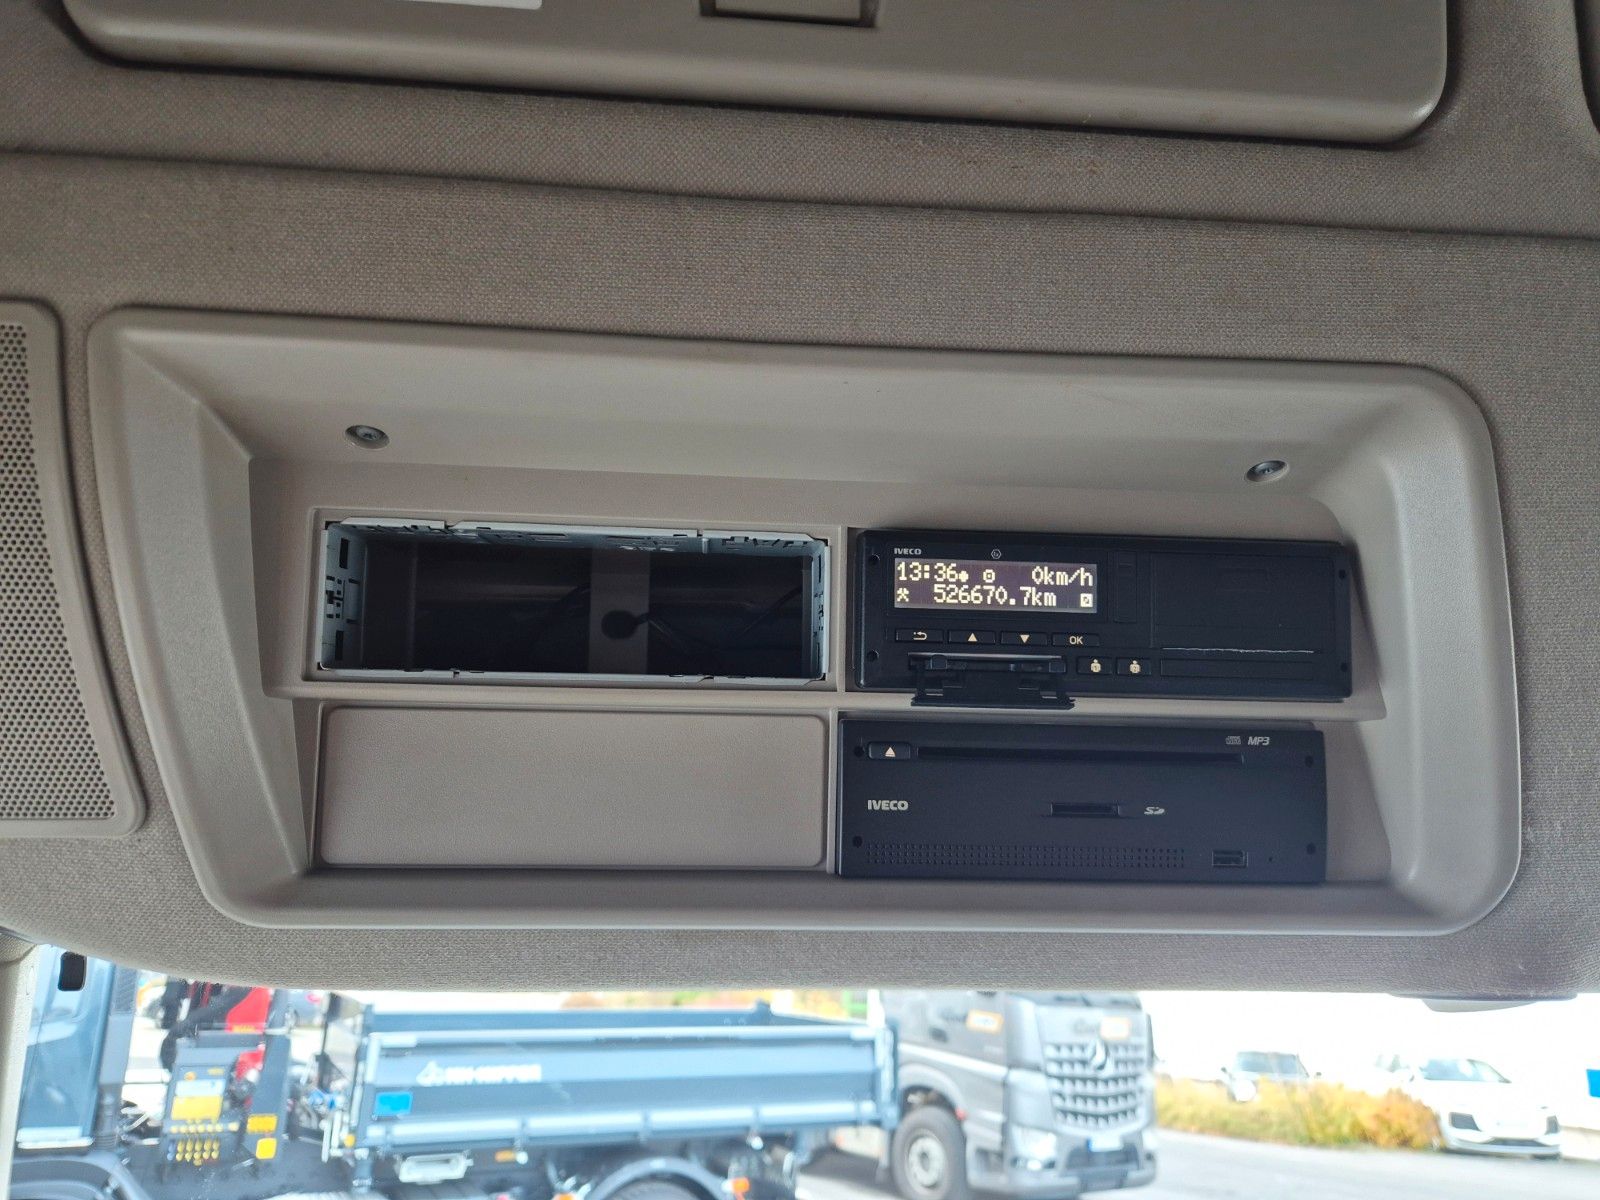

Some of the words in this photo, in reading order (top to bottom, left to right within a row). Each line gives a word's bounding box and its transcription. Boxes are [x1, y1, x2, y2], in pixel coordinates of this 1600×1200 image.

[894, 547, 922, 556] IVECO
[897, 561, 957, 582] 13:36
[1031, 565, 1094, 587] 0km/h
[933, 584, 1057, 608] 526670.7km
[1069, 635, 1084, 645] OK
[1247, 736, 1270, 746] MP3
[867, 799, 909, 811] IVECO
